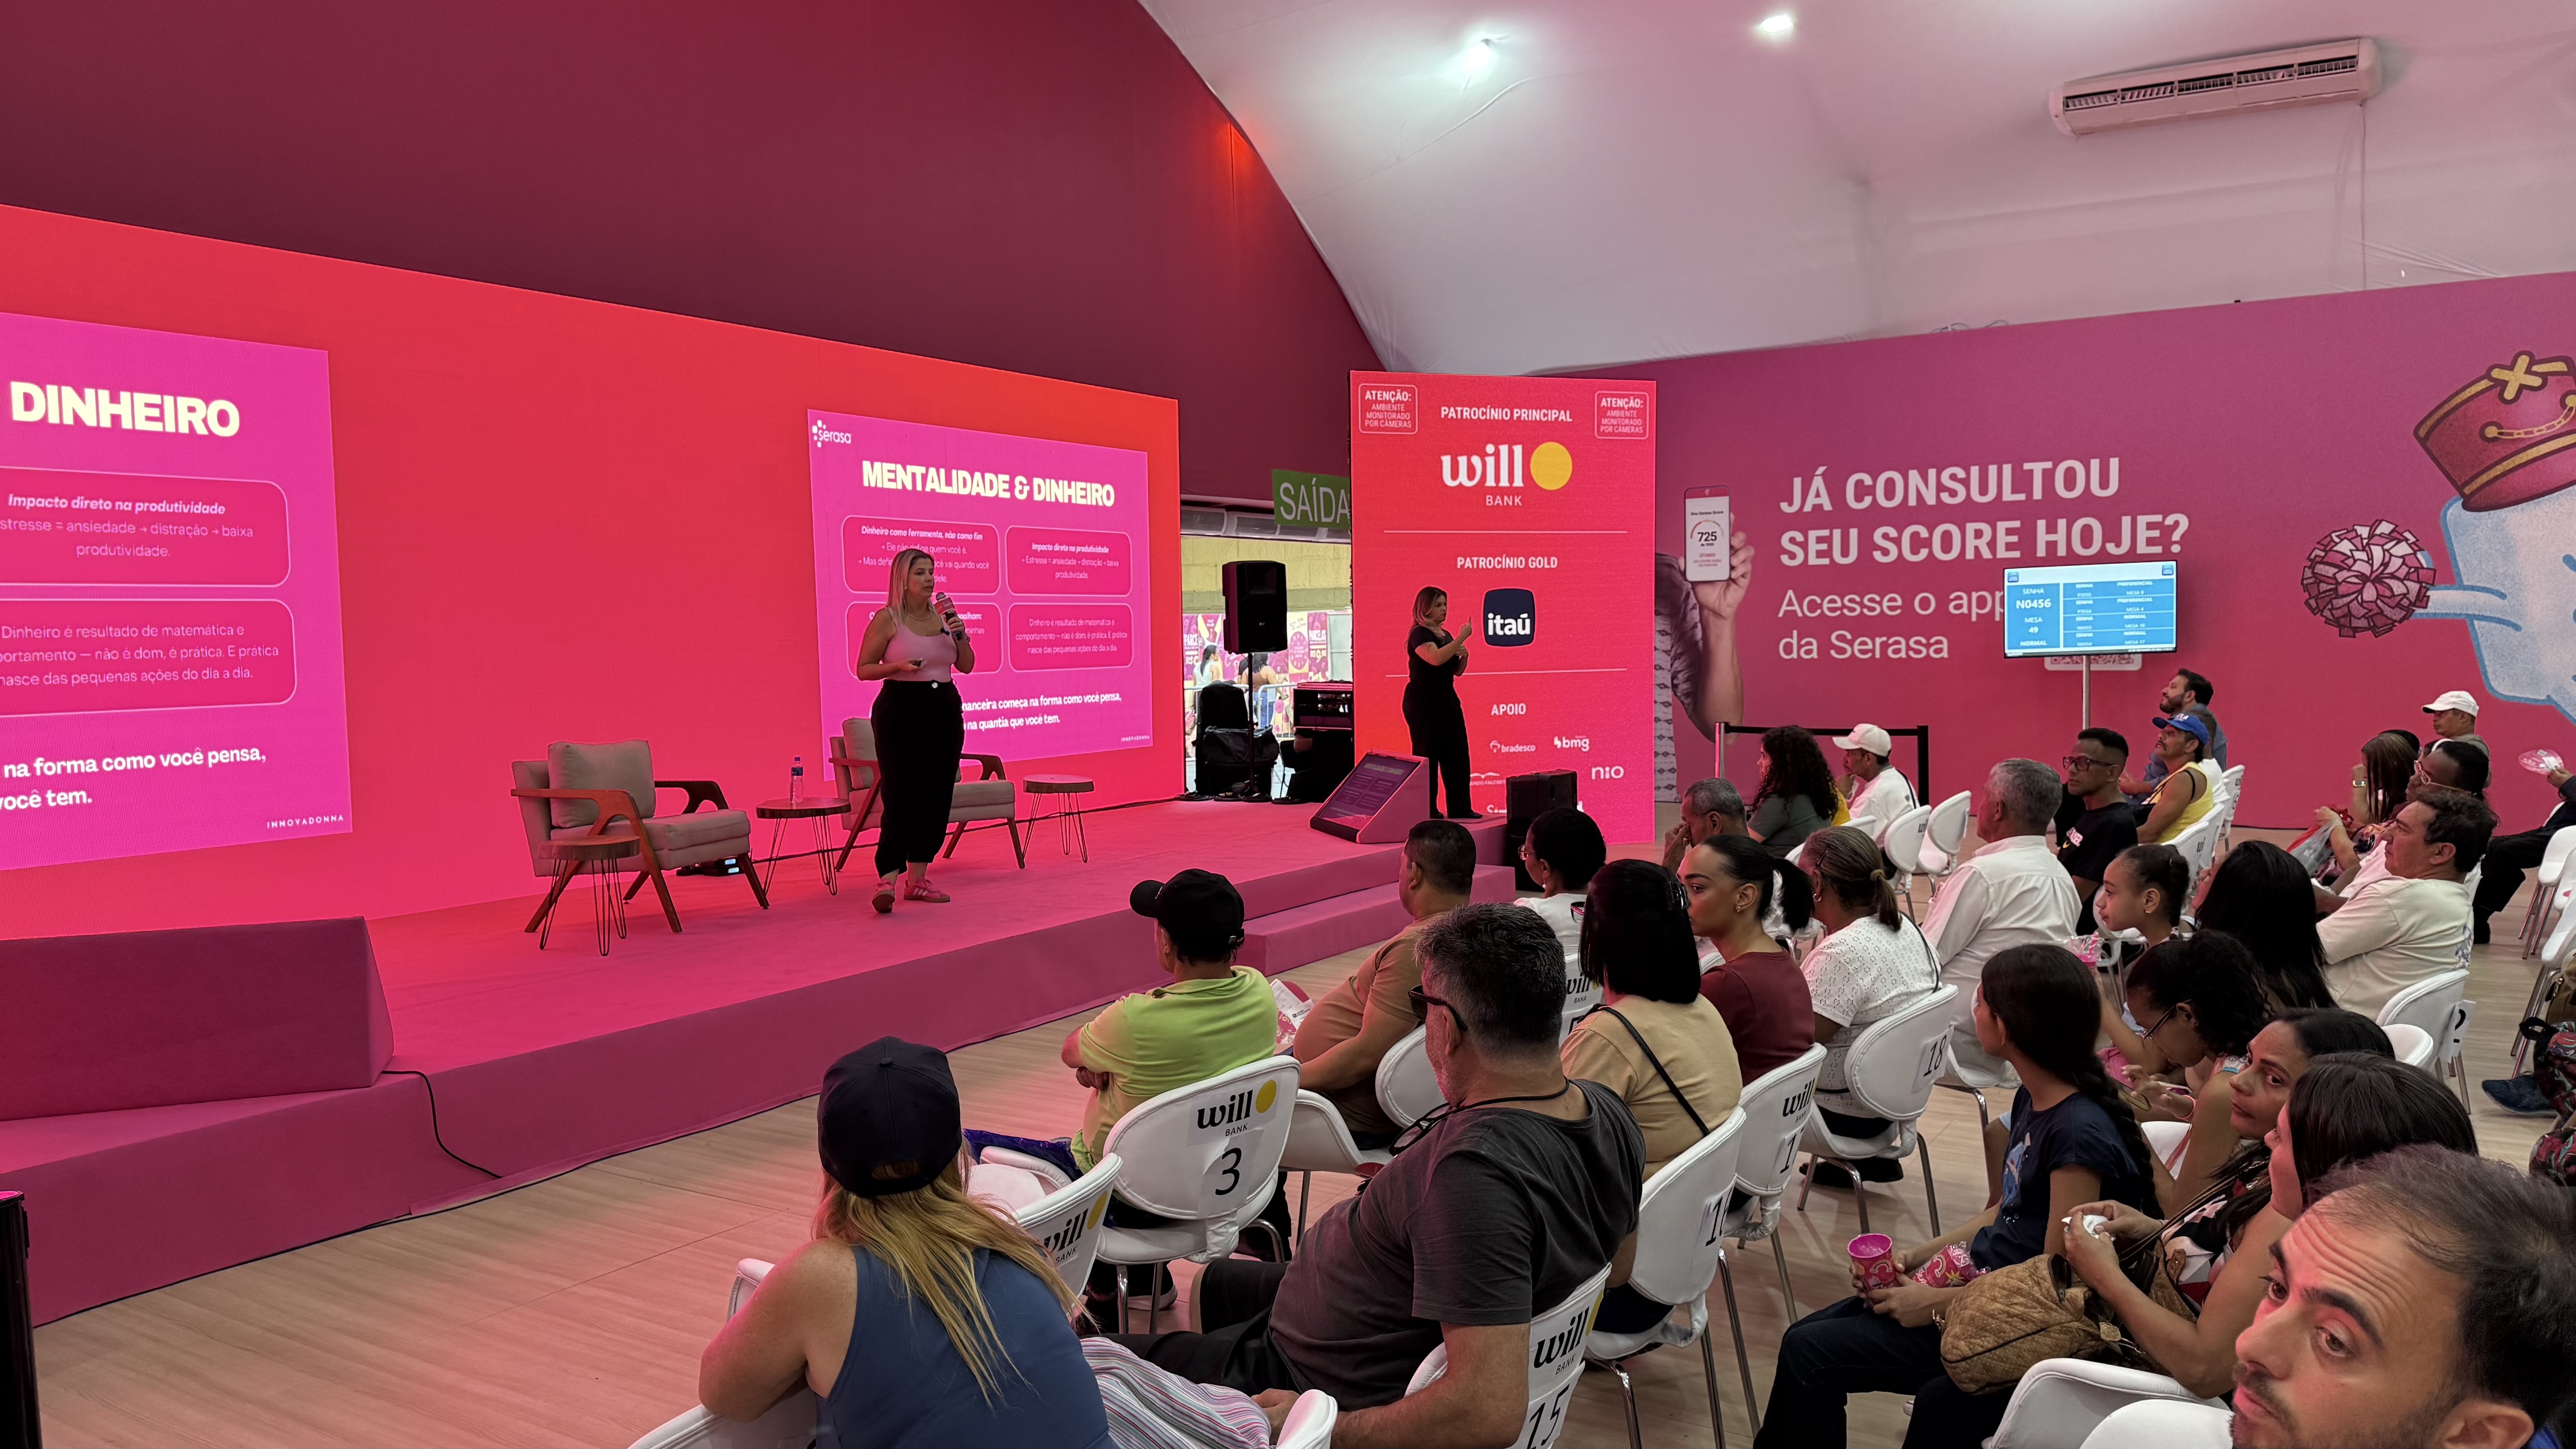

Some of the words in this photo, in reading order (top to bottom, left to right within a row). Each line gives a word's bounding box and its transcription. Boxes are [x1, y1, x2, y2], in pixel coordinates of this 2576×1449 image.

[1365, 390, 1411, 403] ATENÇÃO:
[1601, 396, 1643, 409] ATENÇÃO:
[10, 381, 240, 437] DINHEIRO
[1366, 411, 1410, 419] MONITORADO
[1441, 405, 1510, 420] PATROCÍNIO
[1513, 408, 1573, 422] PRINCIPAL
[1380, 419, 1412, 428] CÂMERAS
[819, 430, 851, 444] serasa
[1440, 443, 1524, 488] will
[862, 460, 1010, 499] MENTALIDADE
[1014, 478, 1030, 500] &
[1033, 479, 1115, 507] DINHEIRO
[1780, 466, 1832, 513] JÁ
[1846, 458, 2119, 509] CONSULTOU
[8, 494, 68, 510] Impacto
[71, 496, 112, 510] direto
[115, 501, 132, 511] na
[135, 500, 225, 514] produtividade
[1279, 478, 1350, 524] SAÍDA
[1486, 495, 1523, 506] BANK
[0, 518, 52, 531] stresse
[66, 520, 136, 534] ansiedade
[151, 522, 208, 538] distração
[222, 524, 253, 537] baixa
[861, 525, 888, 535] Dinheiro
[889, 529, 907, 537] como
[944, 531, 956, 539] não
[957, 532, 973, 540] como
[1697, 531, 1717, 542] 725
[1780, 528, 1858, 566] SEU
[1872, 520, 2021, 563] SCORE
[2037, 513, 2189, 557] HOJE?
[77, 543, 171, 558] produtividade.
[1457, 554, 1525, 569] PATROCÍNIO
[1528, 557, 1558, 568] GOLD
[1778, 589, 1902, 617] Acesse
[1914, 592, 1936, 615] o
[2016, 598, 2052, 609] N0456
[2, 626, 60, 639] Dinheiro
[64, 626, 73, 638] é
[77, 625, 138, 638] resultado
[142, 625, 158, 636] de
[162, 624, 234, 636] matemática
[237, 626, 244, 635] e
[1488, 613, 1531, 636] itaú
[95, 647, 119, 660] não
[123, 647, 131, 659] é
[134, 647, 165, 660] dom,
[169, 646, 176, 658] é
[180, 645, 225, 661] prática.
[228, 645, 235, 657] E
[239, 644, 278, 659] prática
[1779, 630, 1818, 659] da
[1830, 630, 1948, 659] Serasa
[43, 672, 68, 685] das
[71, 672, 137, 687] pequenas
[141, 669, 179, 685] ações
[182, 668, 198, 680] do
[202, 667, 219, 679] dia
[223, 670, 229, 678] a
[233, 667, 253, 678] dia.
[962, 699, 997, 711] nanceira
[998, 699, 1028, 710] começa
[1029, 698, 1038, 707] na
[1040, 695, 1062, 706] forma
[1063, 695, 1082, 704] como
[1083, 691, 1099, 702] você
[1100, 692, 1122, 704] pensa,
[1491, 704, 1526, 715] APOIO
[967, 722, 977, 730] na
[979, 716, 1009, 731] quantia
[1010, 718, 1024, 729] que
[1025, 713, 1043, 725] você
[1044, 714, 1060, 723] tem.
[1502, 744, 1536, 753] bradesco
[1563, 737, 1589, 752] bmg
[4, 764, 30, 778] na
[33, 758, 99, 776] forma
[102, 755, 155, 771] como
[160, 747, 203, 766] você
[207, 748, 266, 768] pensa,
[1592, 766, 1624, 779] nio
[46, 790, 92, 806] tem.
[267, 814, 344, 829] INNOVADONNA
[1923, 1034, 1947, 1077] 18
[1783, 1077, 1815, 1117] will
[1197, 1089, 1253, 1130] will
[1225, 1124, 1247, 1136] BANK
[1215, 1148, 1242, 1196] 3
[1533, 1306, 1590, 1368] will
[1555, 1356, 1575, 1375] BANK
[1527, 1384, 1569, 1449] 15
